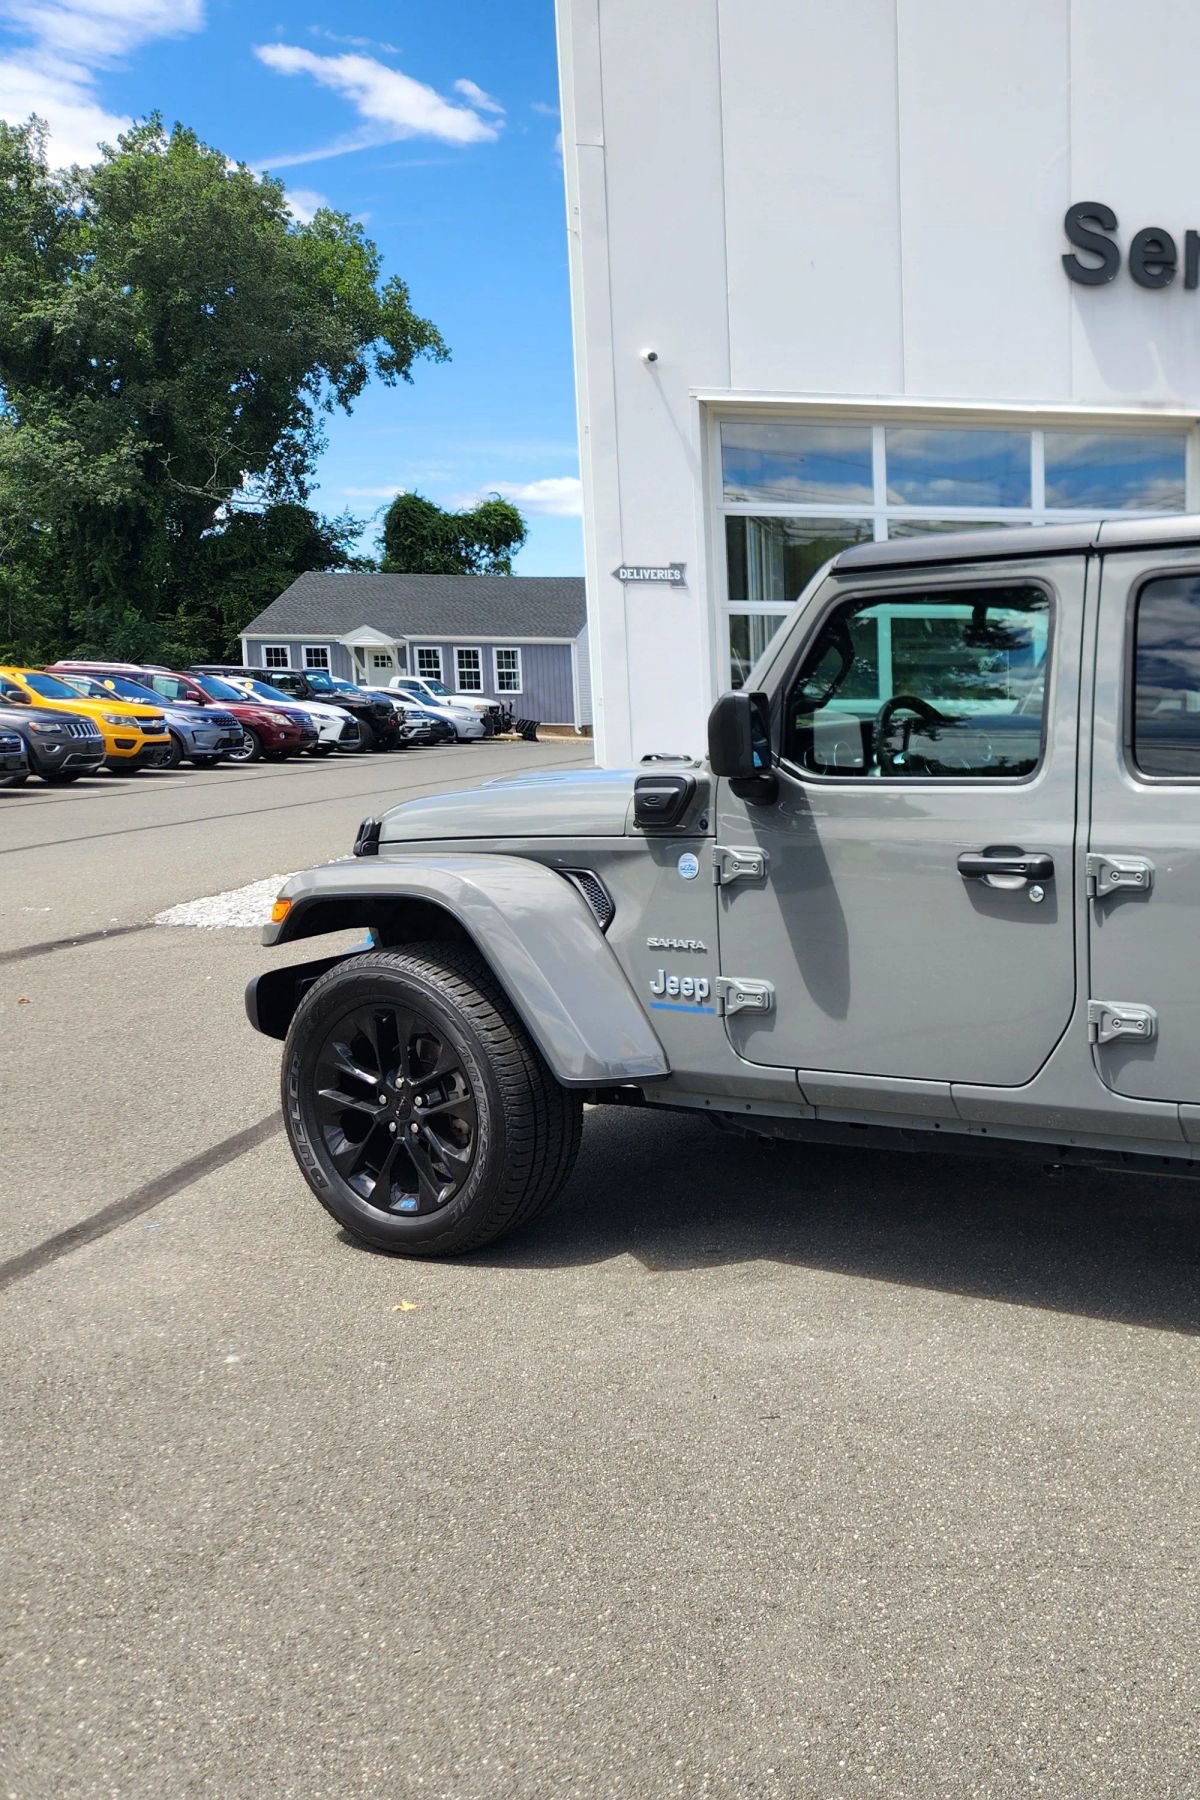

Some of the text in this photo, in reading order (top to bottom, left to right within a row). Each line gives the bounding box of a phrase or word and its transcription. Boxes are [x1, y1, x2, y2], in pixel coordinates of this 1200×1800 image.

[619, 568, 681, 580] DELIVERIES
[646, 937, 706, 949] SAHARA
[649, 969, 709, 1002] Jeep
